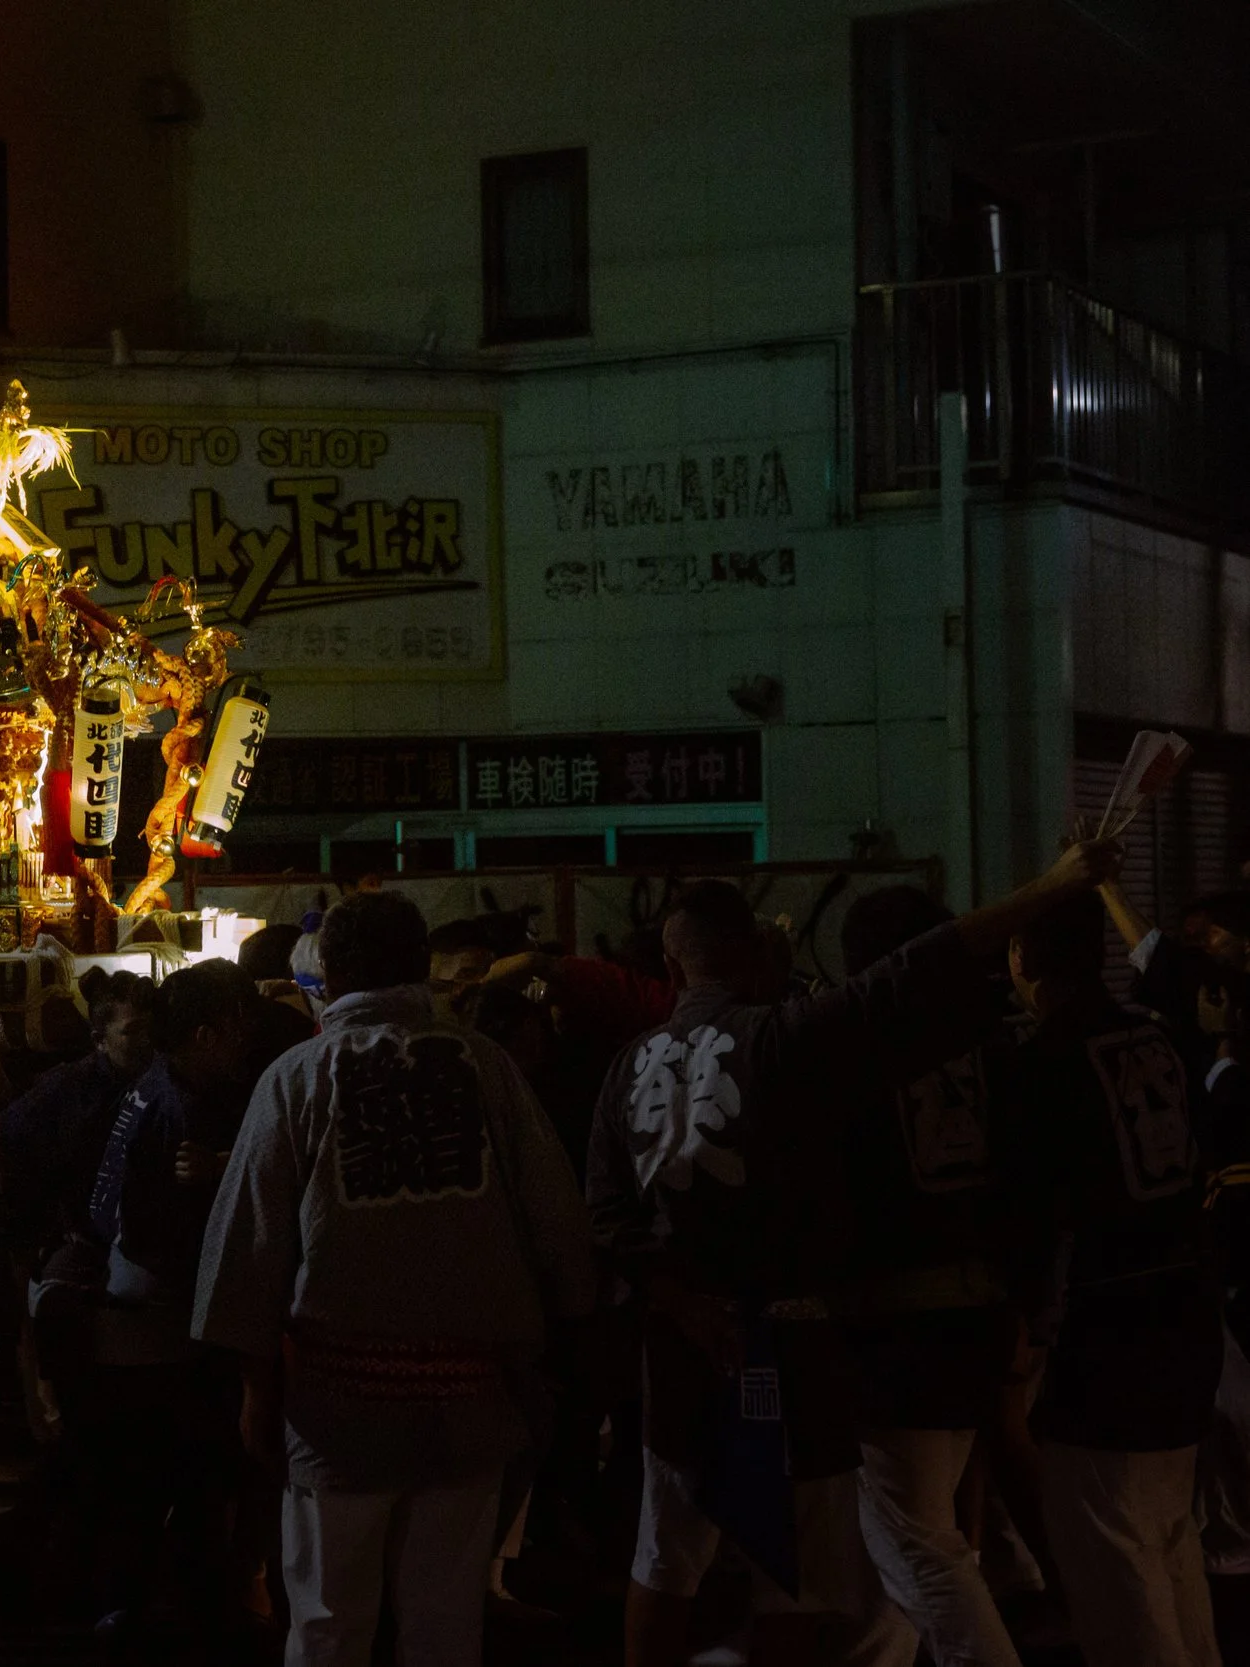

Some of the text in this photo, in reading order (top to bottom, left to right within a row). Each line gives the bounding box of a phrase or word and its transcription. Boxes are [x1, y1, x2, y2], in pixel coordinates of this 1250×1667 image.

[94, 424, 388, 469] MOTO SHOP
[545, 450, 794, 532] YAMAHA
[544, 547, 796, 600] SUZUKI
[475, 746, 748, 806] 車検随時 受付中!
